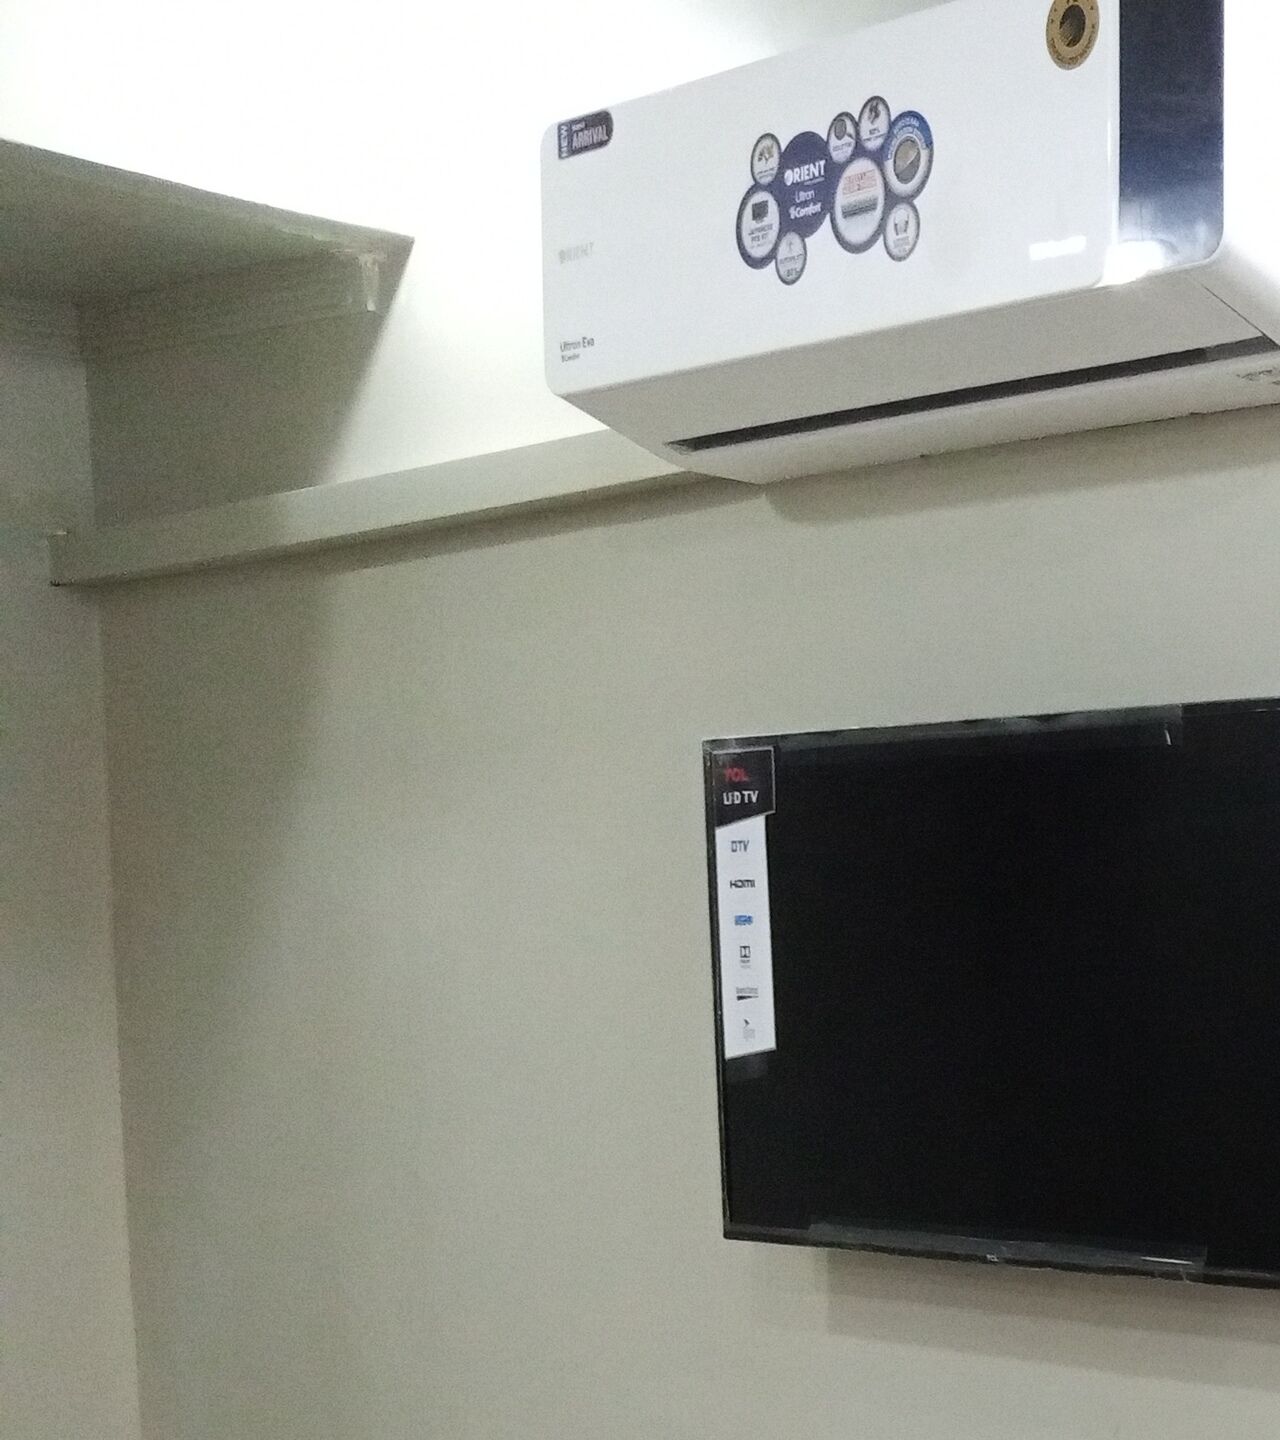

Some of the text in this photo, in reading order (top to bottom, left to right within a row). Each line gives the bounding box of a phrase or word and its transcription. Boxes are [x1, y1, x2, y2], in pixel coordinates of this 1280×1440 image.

[560, 125, 569, 158] NEW
[572, 124, 609, 150] ARRIVAL
[784, 159, 826, 187] ORIENT
[725, 767, 750, 783] TCL
[742, 790, 760, 804] TV
[731, 840, 750, 853] DTV
